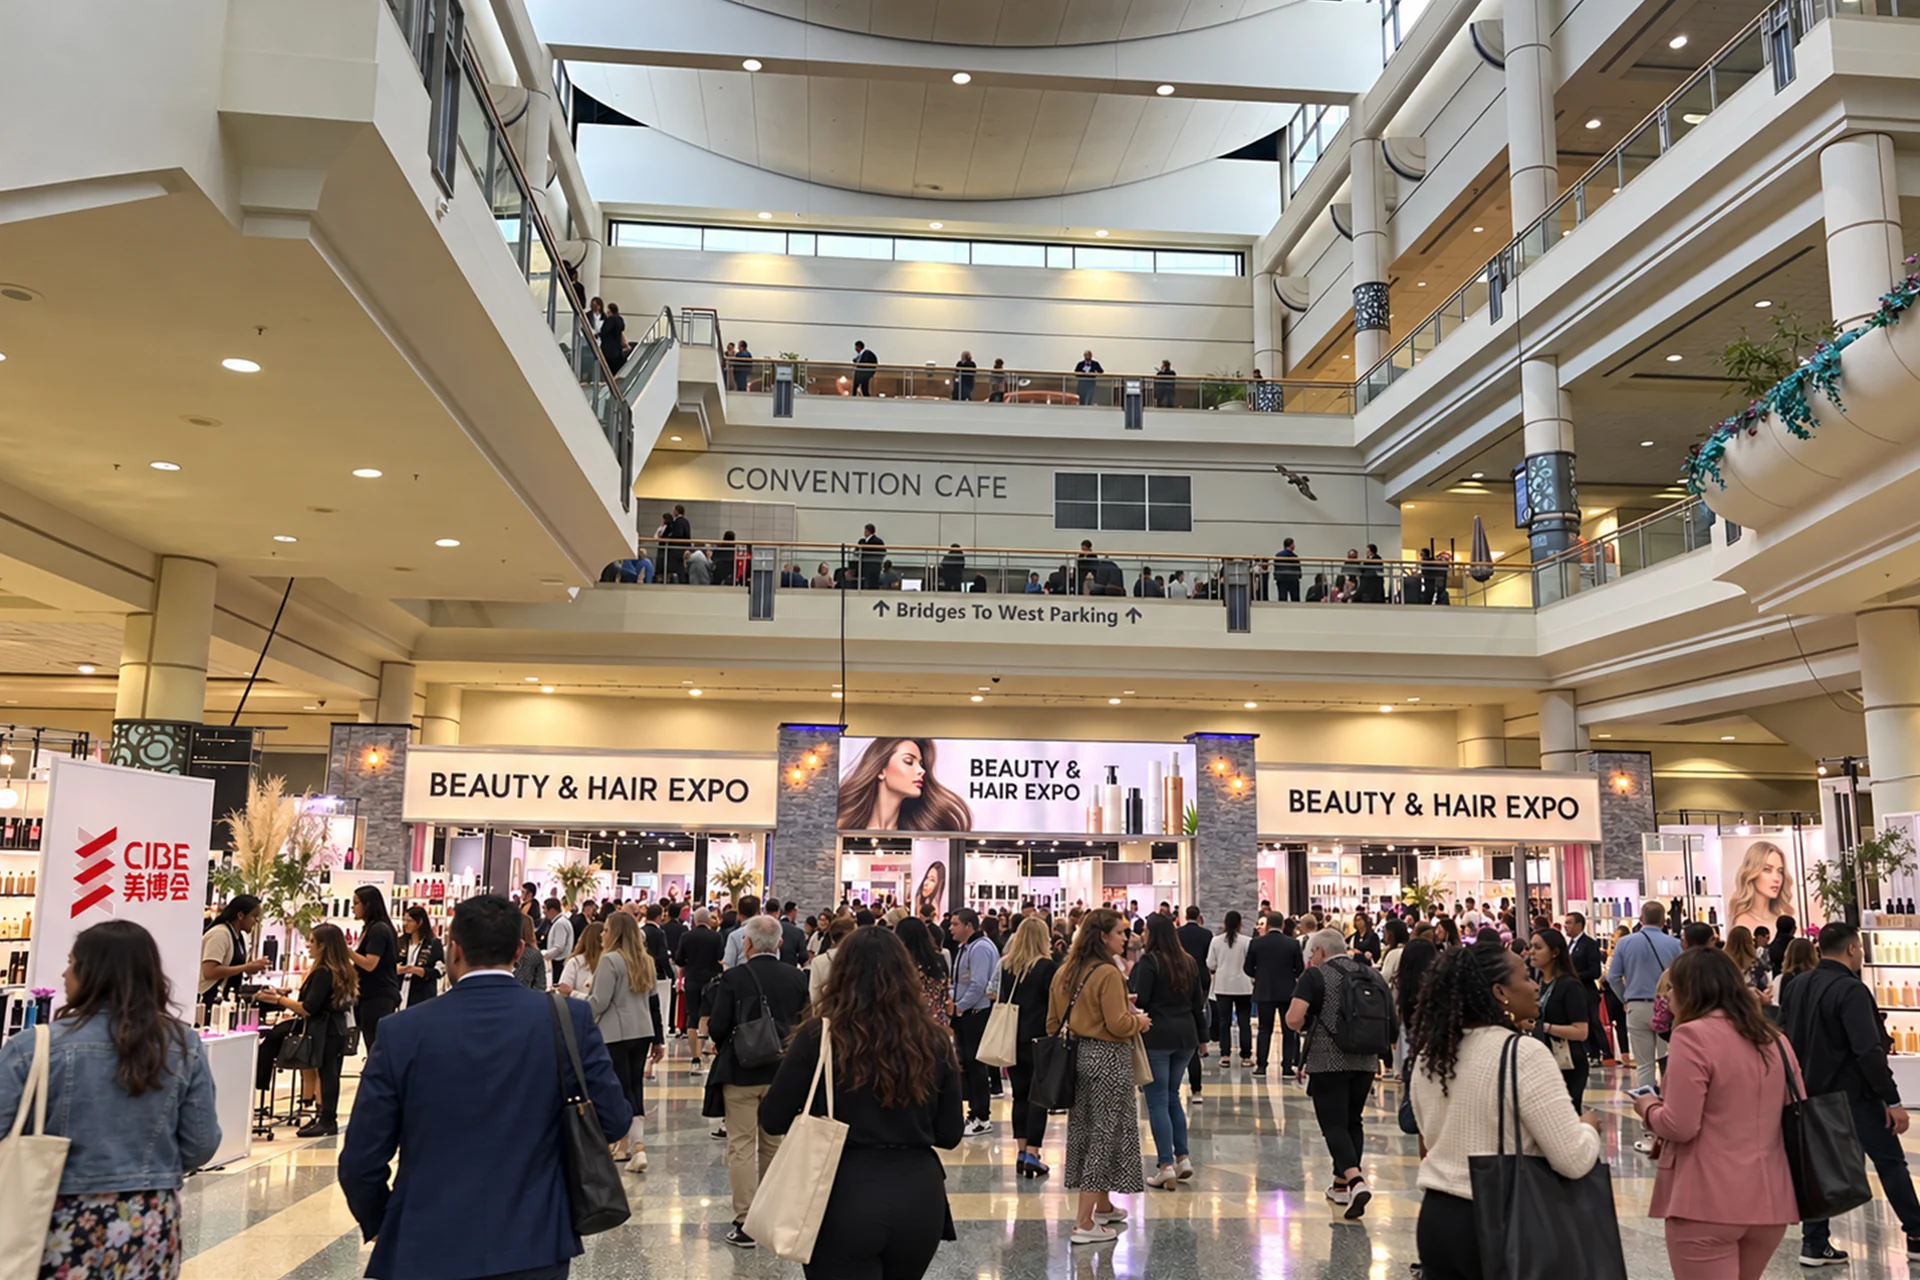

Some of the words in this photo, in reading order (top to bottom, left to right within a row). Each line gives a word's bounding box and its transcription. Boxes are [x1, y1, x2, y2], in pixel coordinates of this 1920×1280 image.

[727, 466, 921, 497] CONVENTION
[934, 473, 1008, 499] CAFE
[897, 602, 966, 623] Bridges
[972, 604, 993, 621] To
[999, 605, 1045, 622] West
[1050, 607, 1119, 628] Parking
[971, 758, 1060, 779] BEAUTY
[1066, 760, 1081, 779] &
[430, 772, 550, 798] BEAUTY
[558, 776, 578, 800] &
[587, 776, 658, 801] HAIR
[668, 777, 749, 803] EXPO
[970, 782, 1018, 800] HAIR
[1025, 783, 1081, 802] EXPO
[1289, 789, 1396, 815] BEAUTY
[1404, 793, 1424, 816] &
[1433, 793, 1497, 818] HAIR
[1506, 795, 1580, 820] EXPO
[123, 841, 191, 871] CIBE
[123, 872, 191, 903] 美博会
